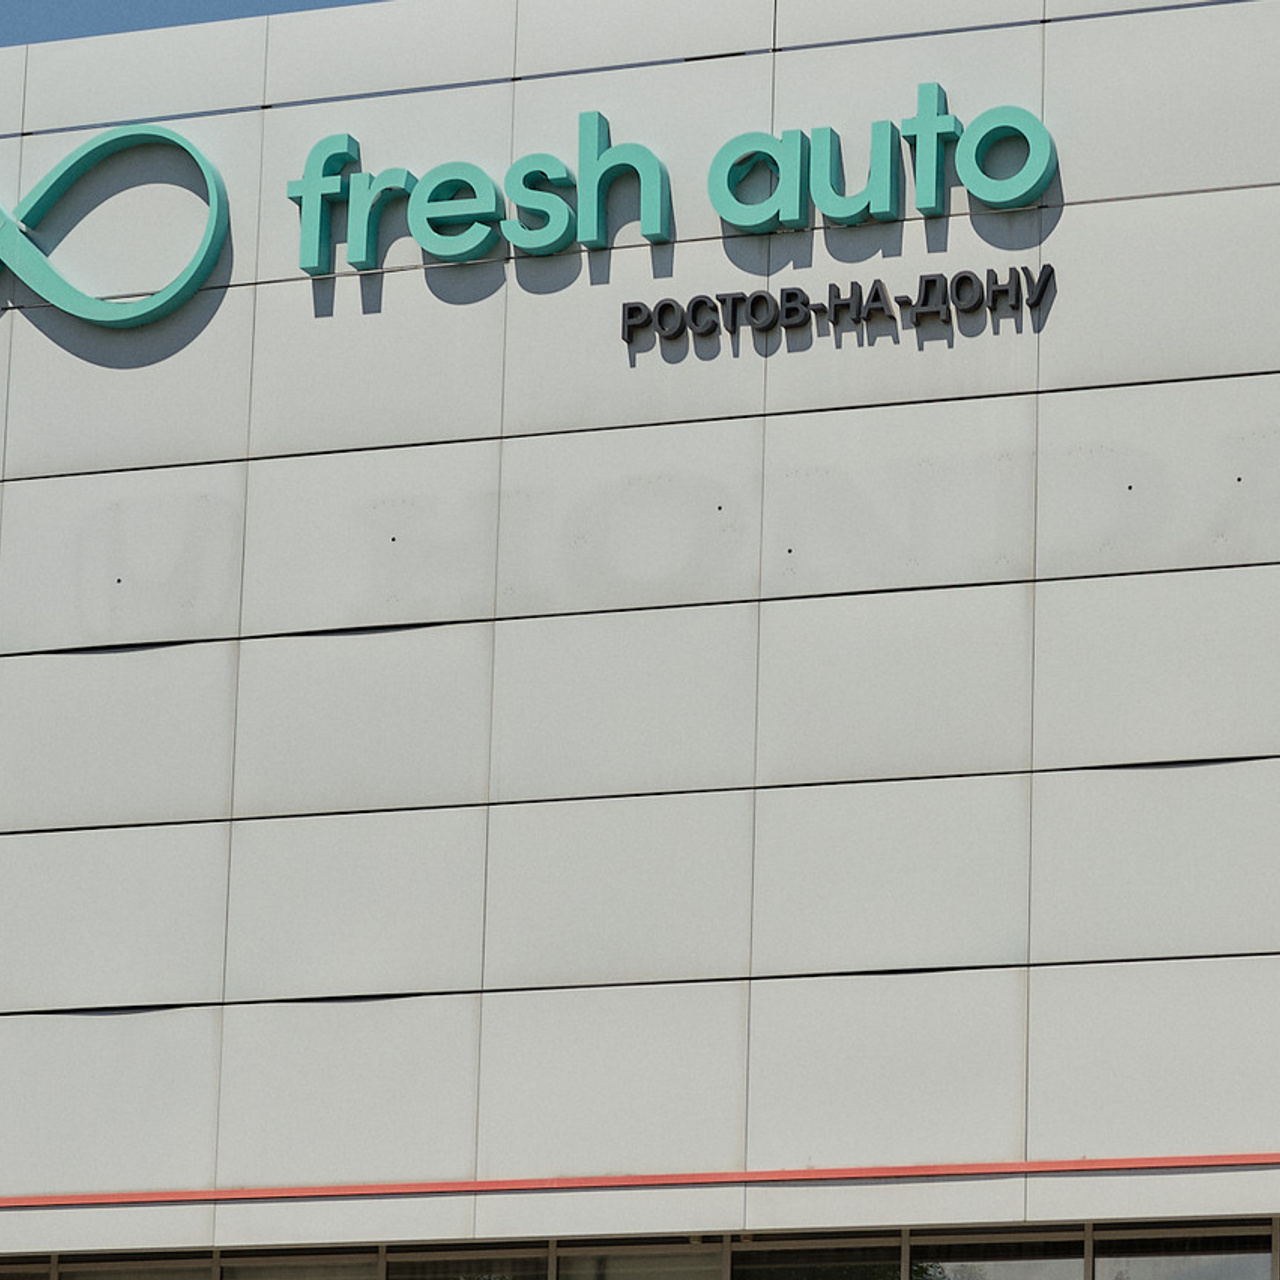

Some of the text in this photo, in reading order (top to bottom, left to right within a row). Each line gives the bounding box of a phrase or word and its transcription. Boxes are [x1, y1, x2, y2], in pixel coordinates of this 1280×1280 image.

[287, 83, 1059, 276] fresh auto
[622, 264, 1056, 344] РОСТОВ-НА-ДОНУ
